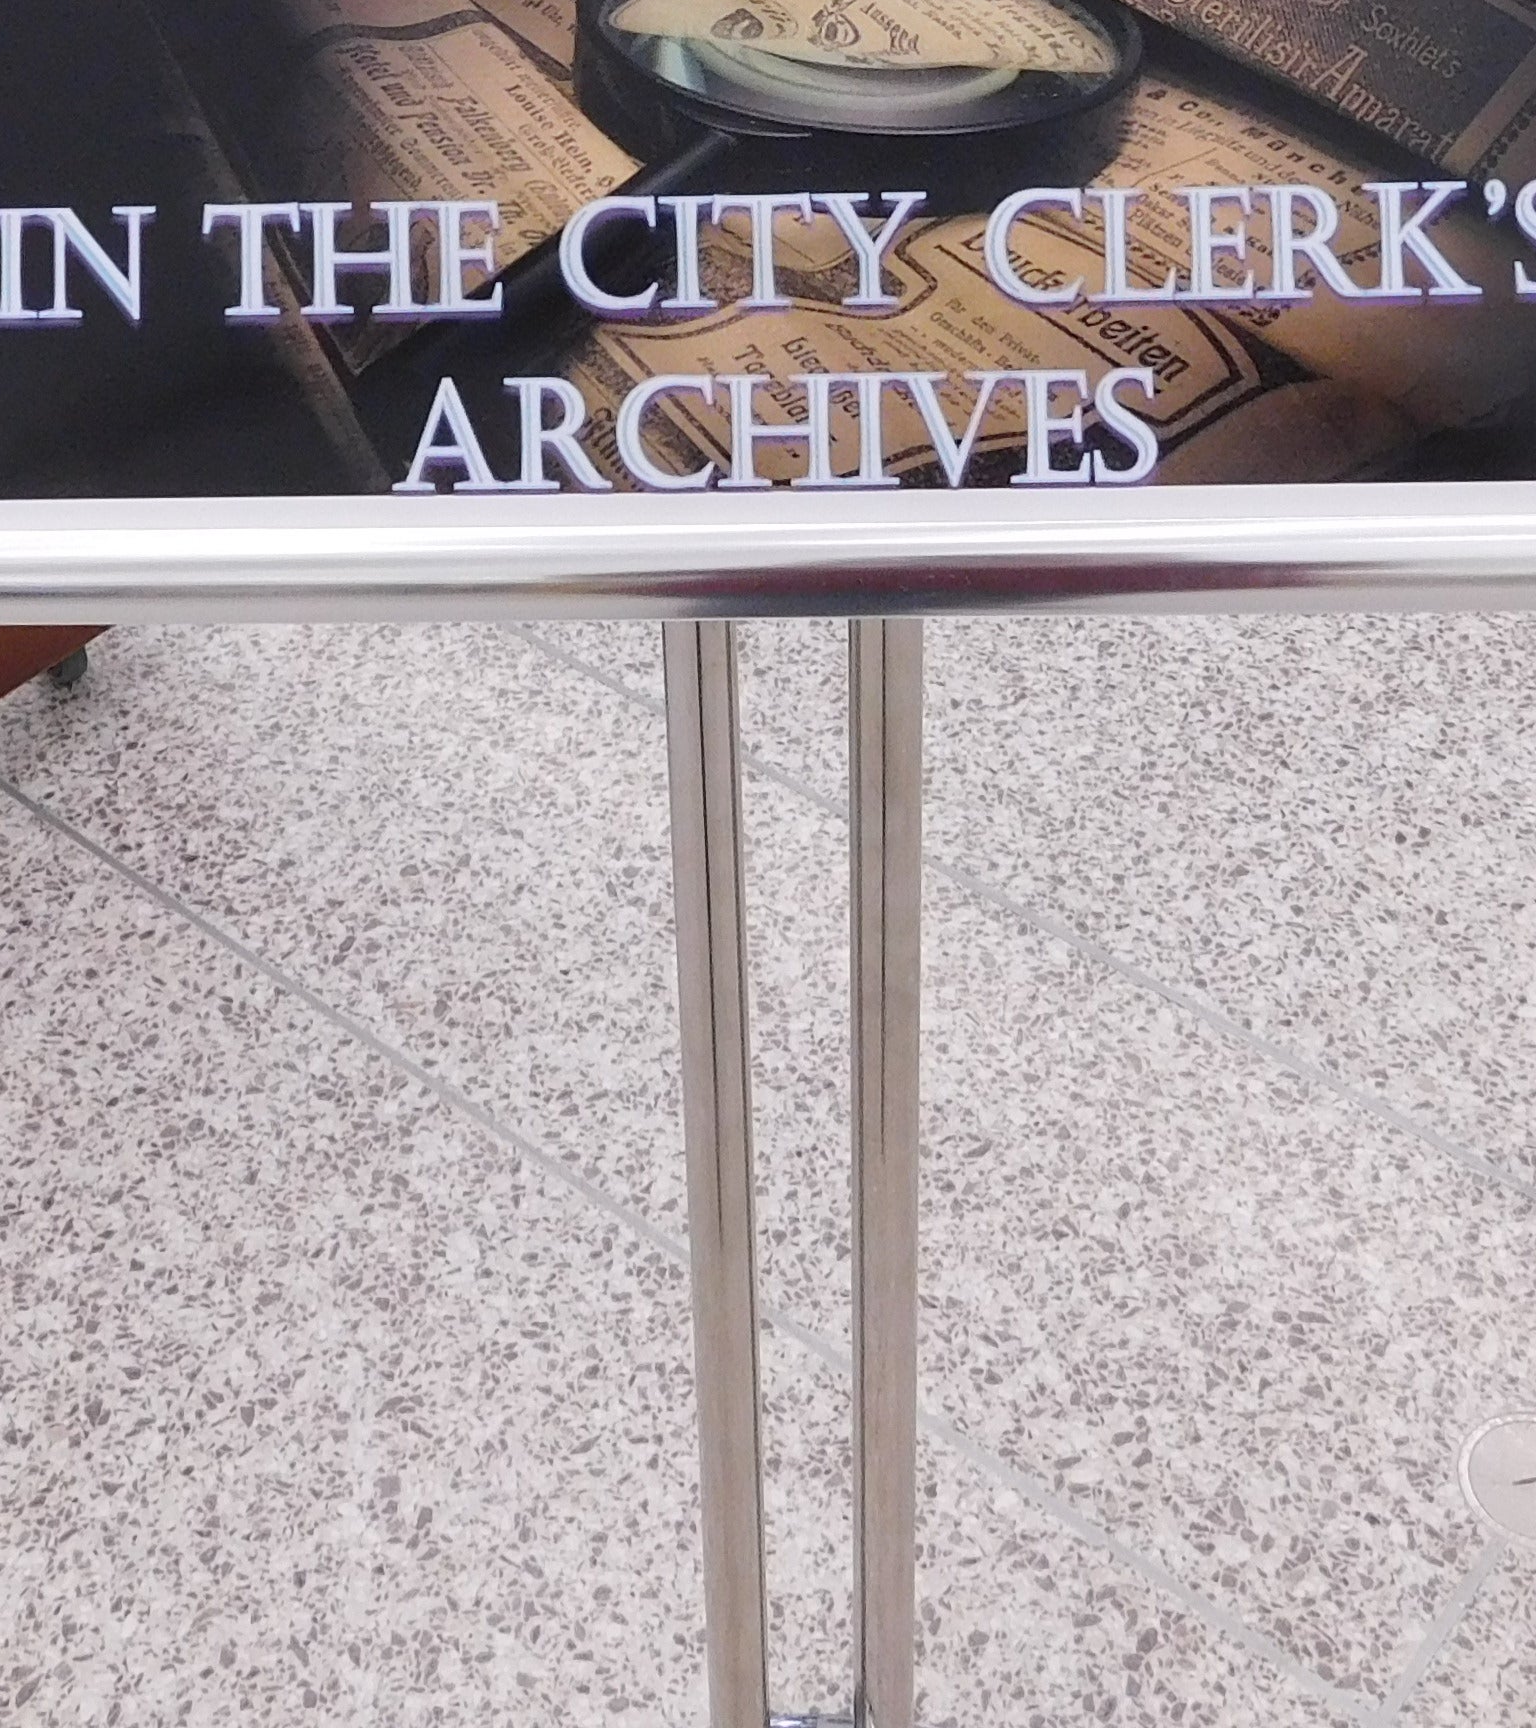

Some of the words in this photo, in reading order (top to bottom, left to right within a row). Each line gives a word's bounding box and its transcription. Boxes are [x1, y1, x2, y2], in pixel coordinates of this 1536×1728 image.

[396, 109, 473, 167] Pension
[504, 83, 555, 132] Louise
[200, 197, 506, 320] THE
[557, 190, 929, 316] CITY
[391, 366, 1160, 494] ARCHIVES
